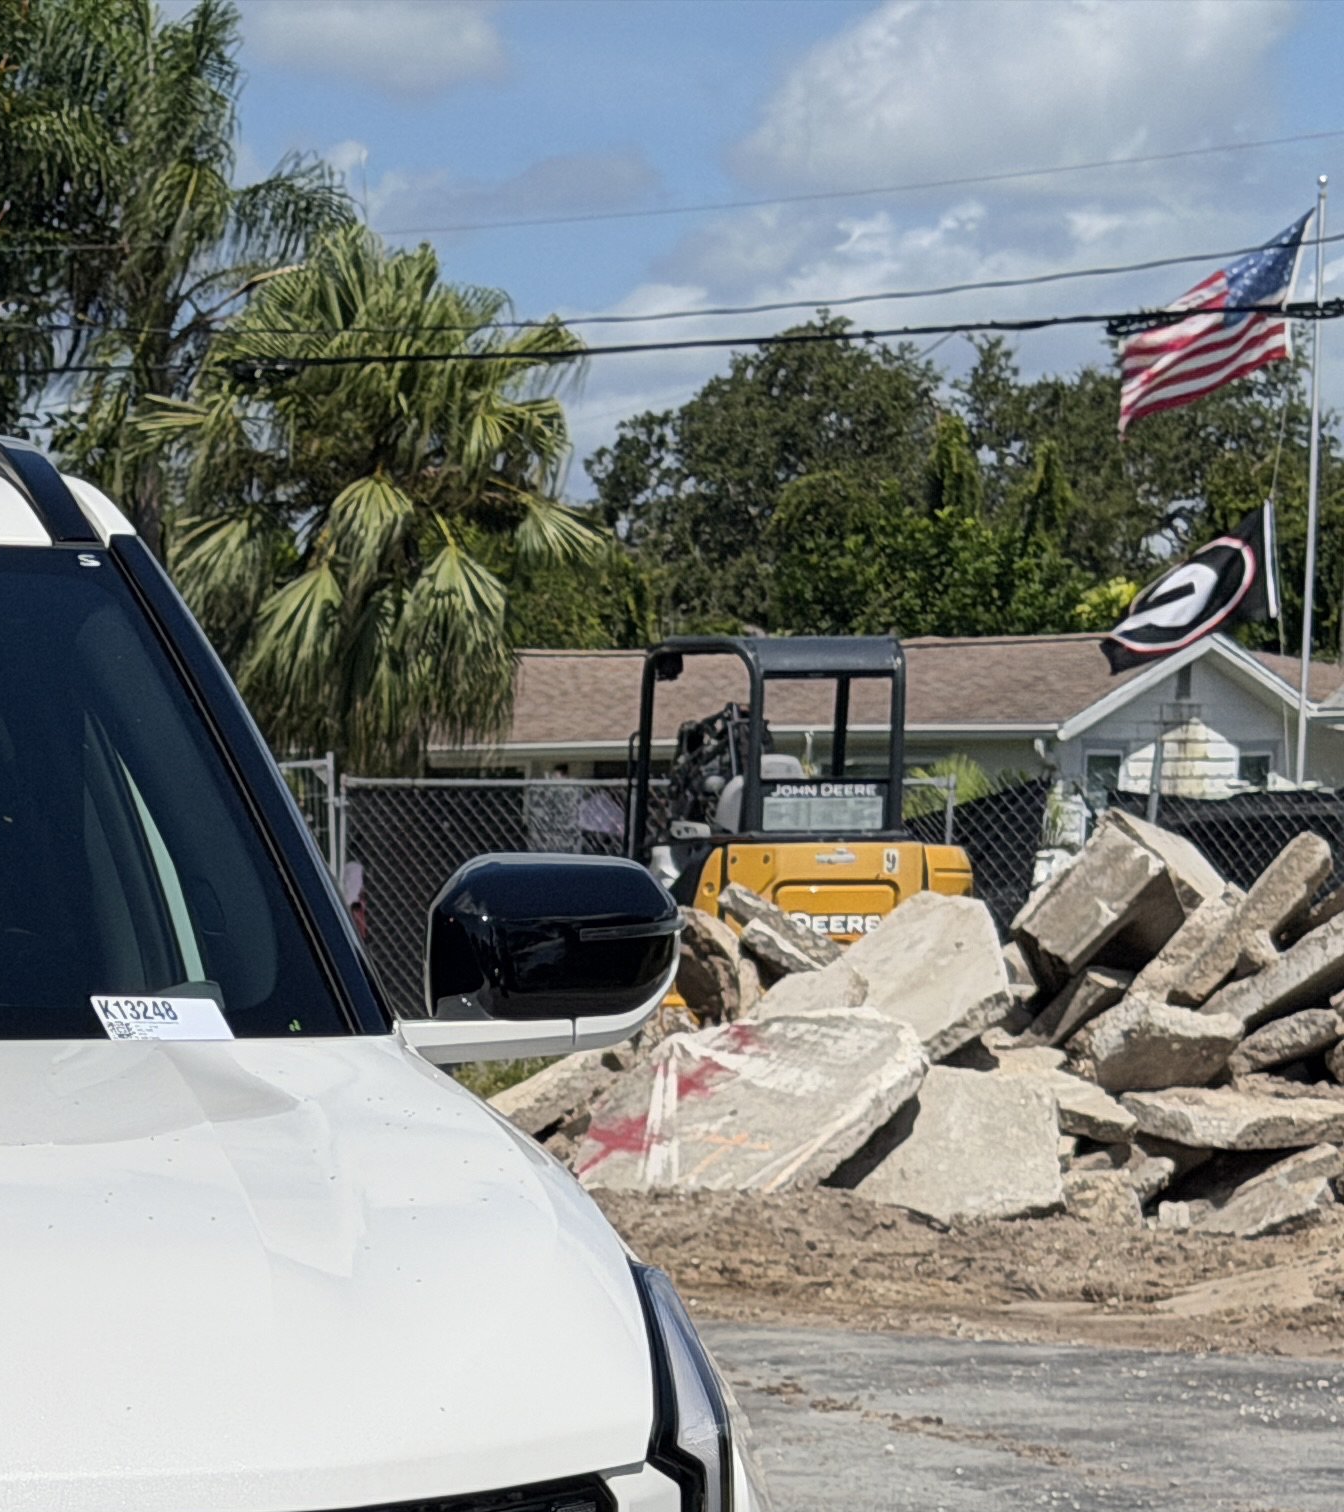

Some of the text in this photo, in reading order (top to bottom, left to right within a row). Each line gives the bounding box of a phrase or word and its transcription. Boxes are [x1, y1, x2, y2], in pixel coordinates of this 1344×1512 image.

[771, 783, 878, 797] JOHN DEERE
[97, 999, 179, 1021] K13248
